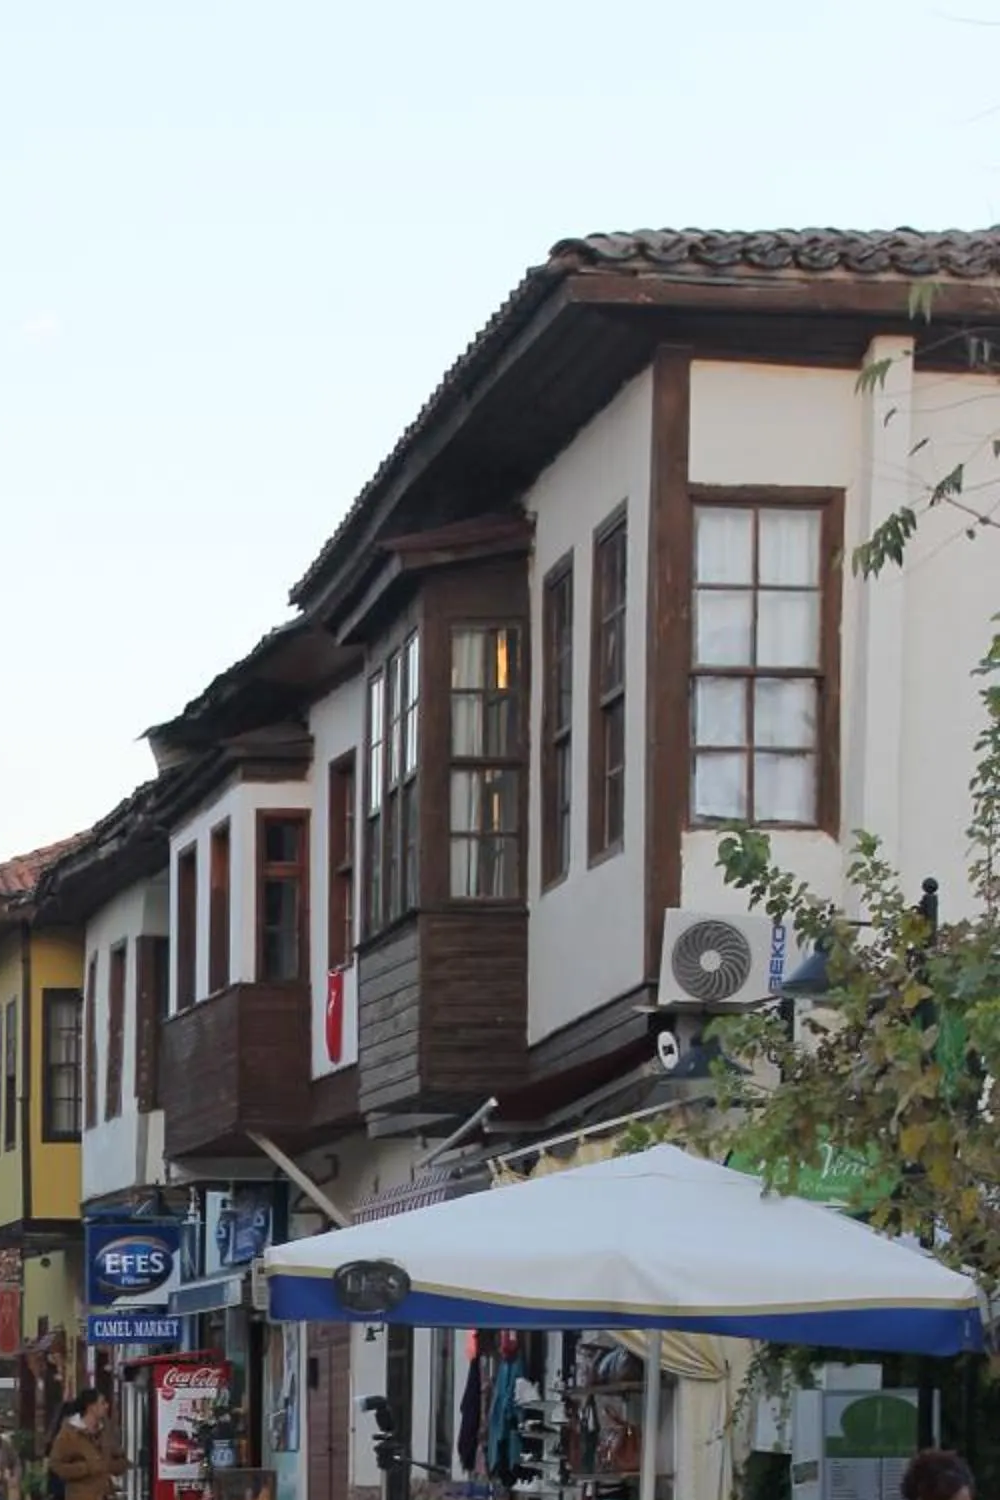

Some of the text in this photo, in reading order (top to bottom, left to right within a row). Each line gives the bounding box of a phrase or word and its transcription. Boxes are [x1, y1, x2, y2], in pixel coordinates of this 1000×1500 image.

[104, 1252, 165, 1274] EFES
[94, 1320, 178, 1338] CAMEL MARKET
[163, 1368, 223, 1388] CocaCola
